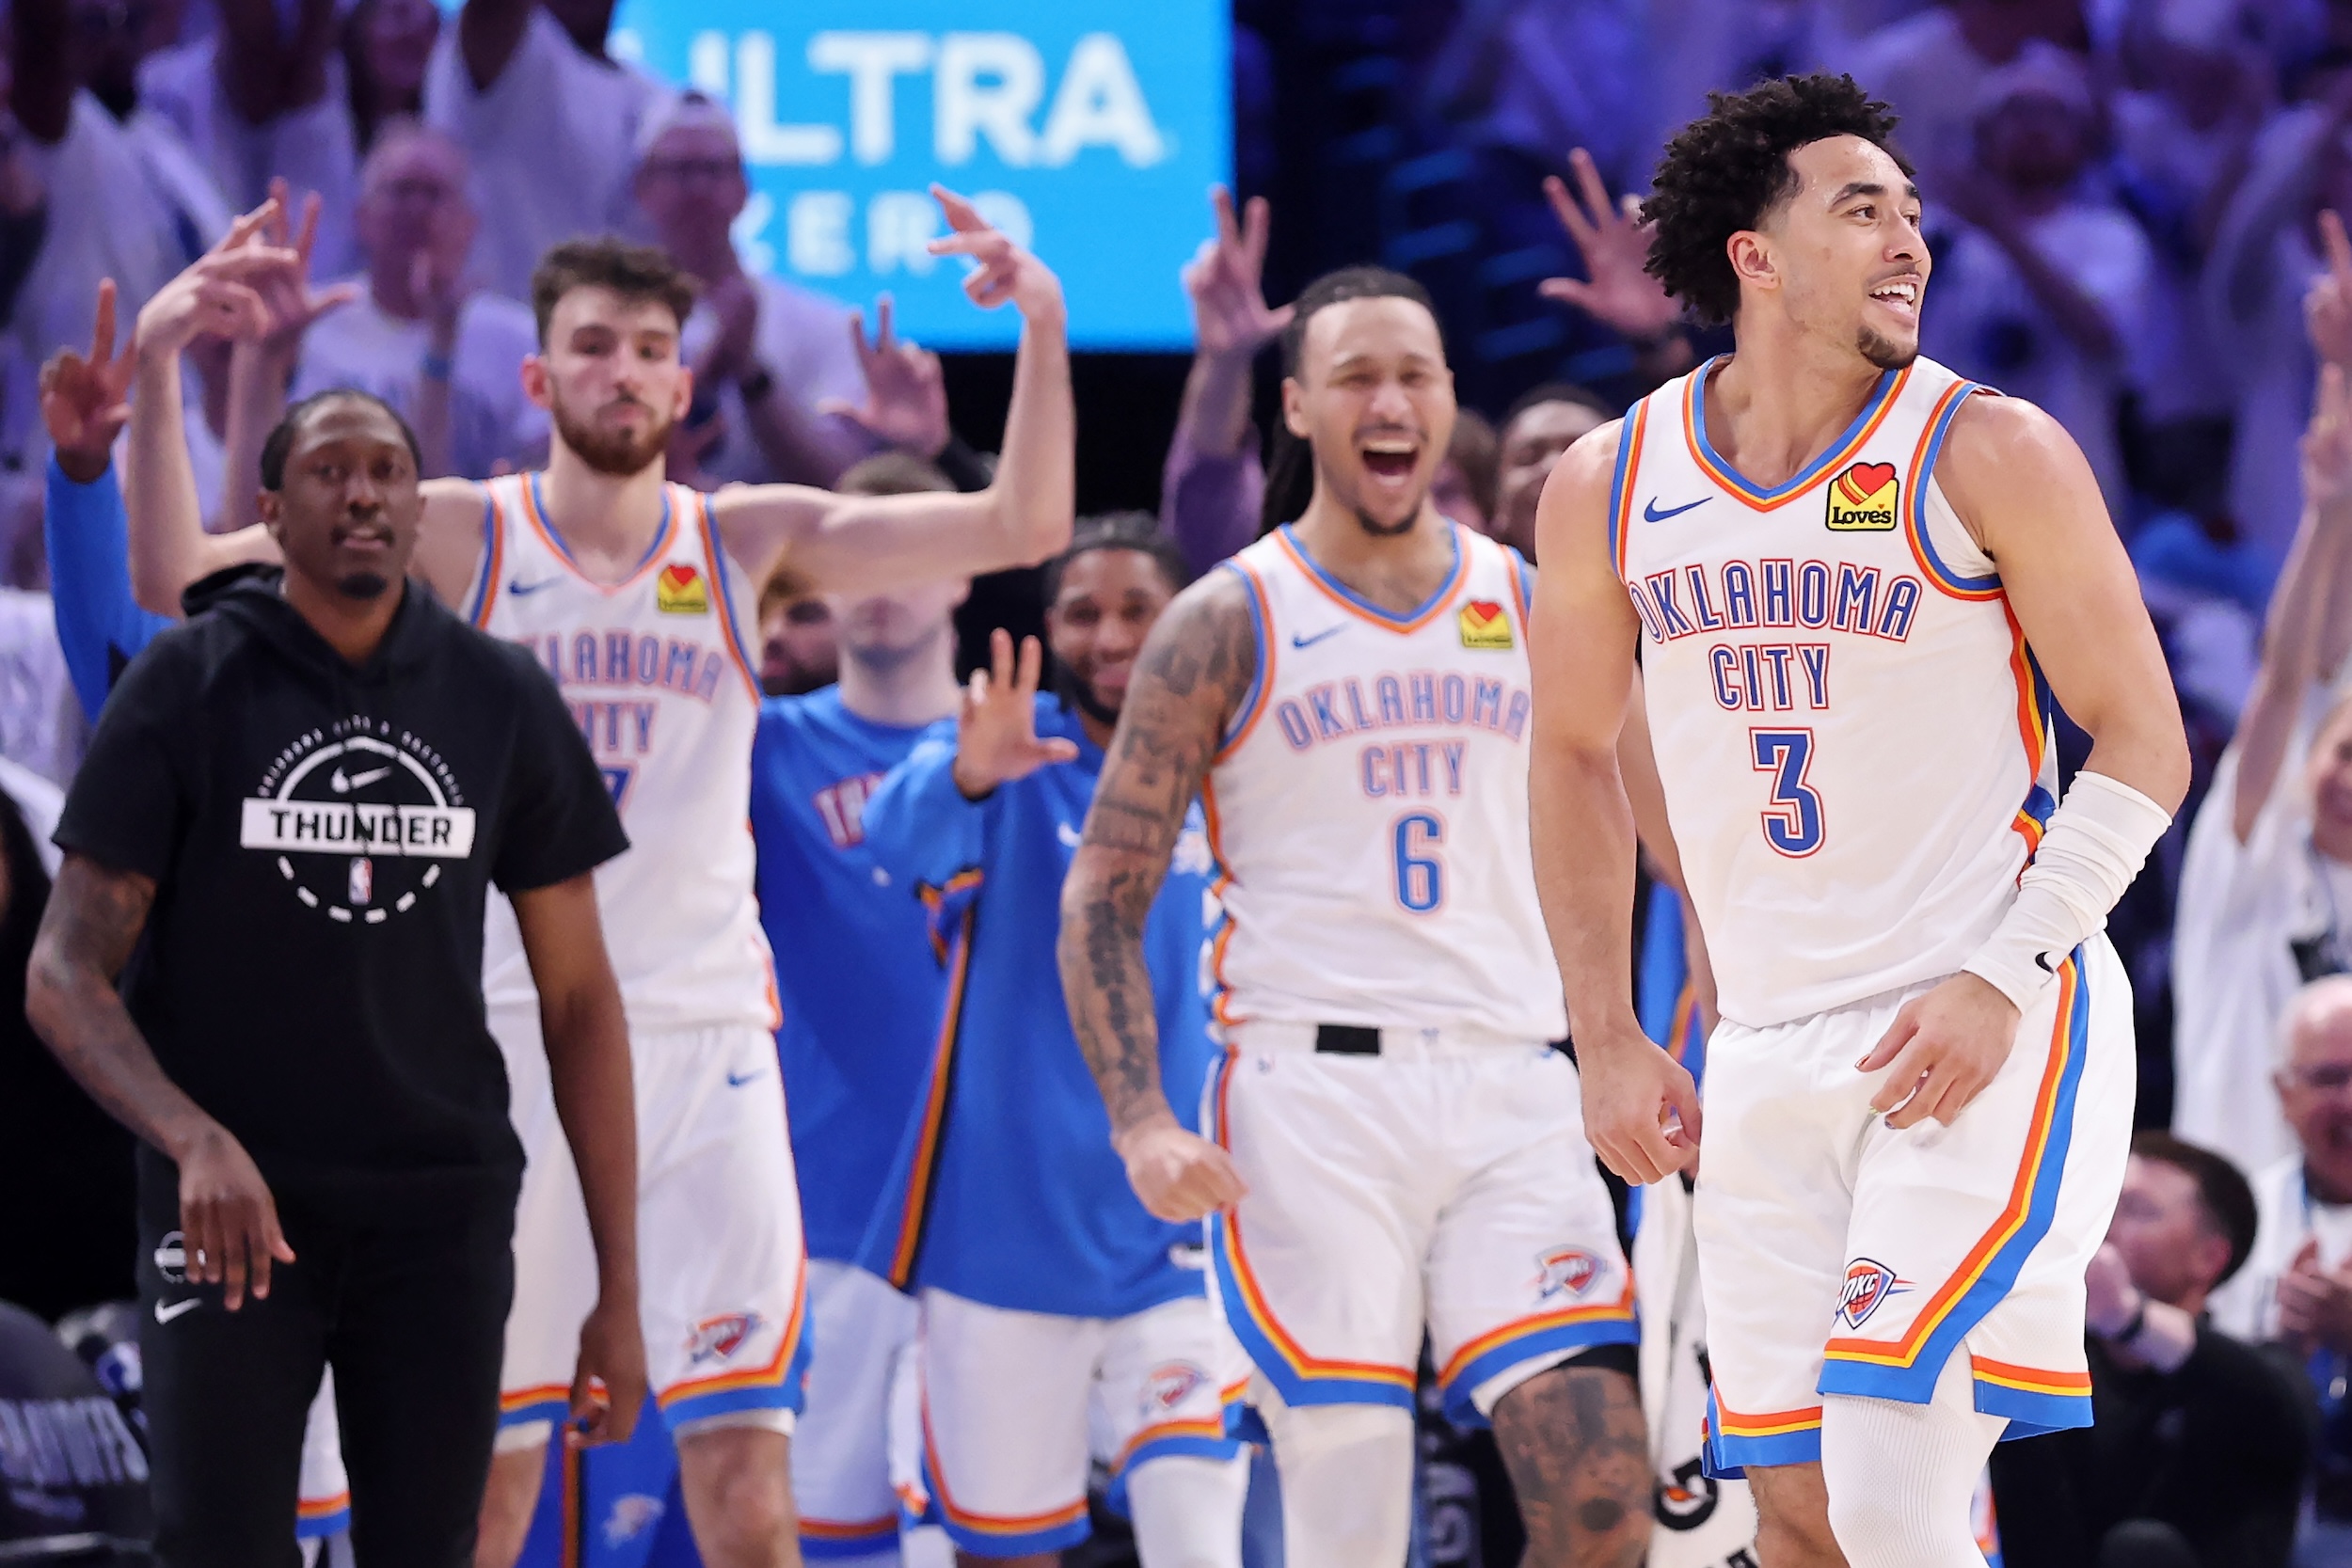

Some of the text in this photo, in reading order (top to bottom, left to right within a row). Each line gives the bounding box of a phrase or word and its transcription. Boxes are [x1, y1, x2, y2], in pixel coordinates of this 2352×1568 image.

[1628, 559, 1922, 644] OKLAHOMA
[519, 626, 723, 704] LAHOMA
[1708, 643, 1831, 712] CITY
[568, 698, 660, 755] ITY
[1275, 669, 1531, 751] OKLAHOMA
[1361, 737, 1470, 799] CITY
[1748, 726, 1826, 859] 3
[270, 809, 452, 846] THUNDER
[1387, 805, 1449, 921] 6
